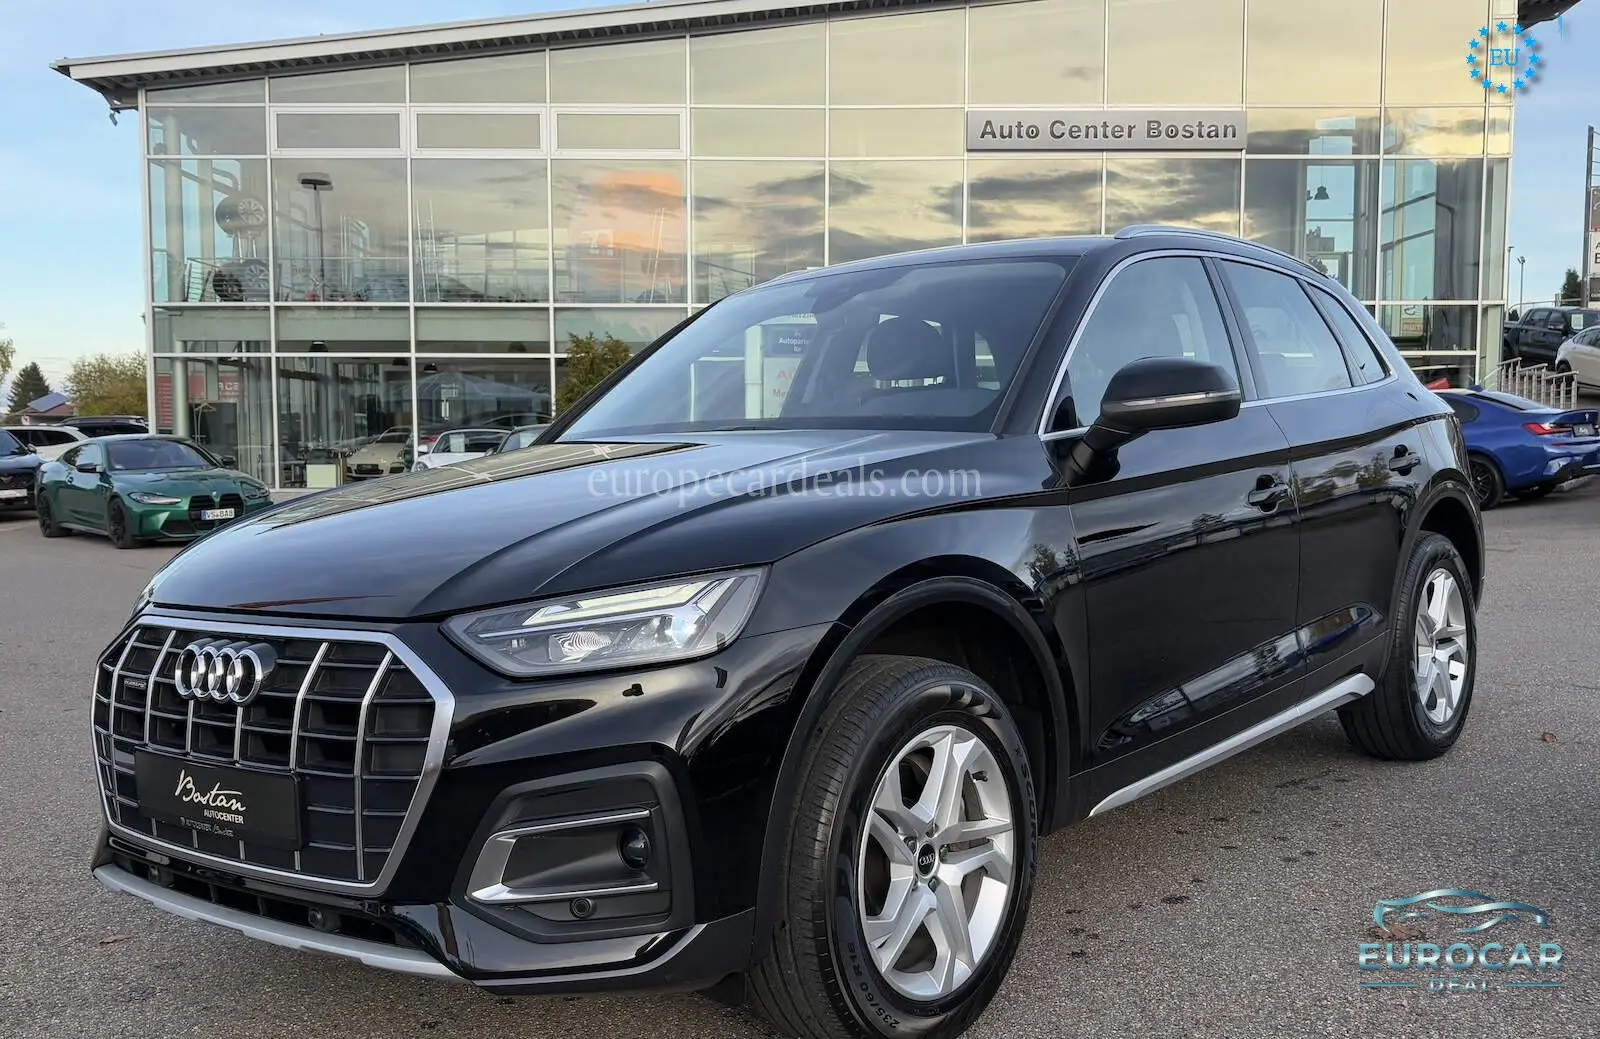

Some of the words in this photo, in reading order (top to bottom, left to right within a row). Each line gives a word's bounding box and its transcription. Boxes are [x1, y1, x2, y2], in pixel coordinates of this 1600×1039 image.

[979, 120, 1040, 139] Auto
[1049, 120, 1136, 139] Center
[1146, 120, 1236, 139] Bostan
[175, 769, 246, 811] Bostan
[203, 809, 244, 824] AUTOCENTER
